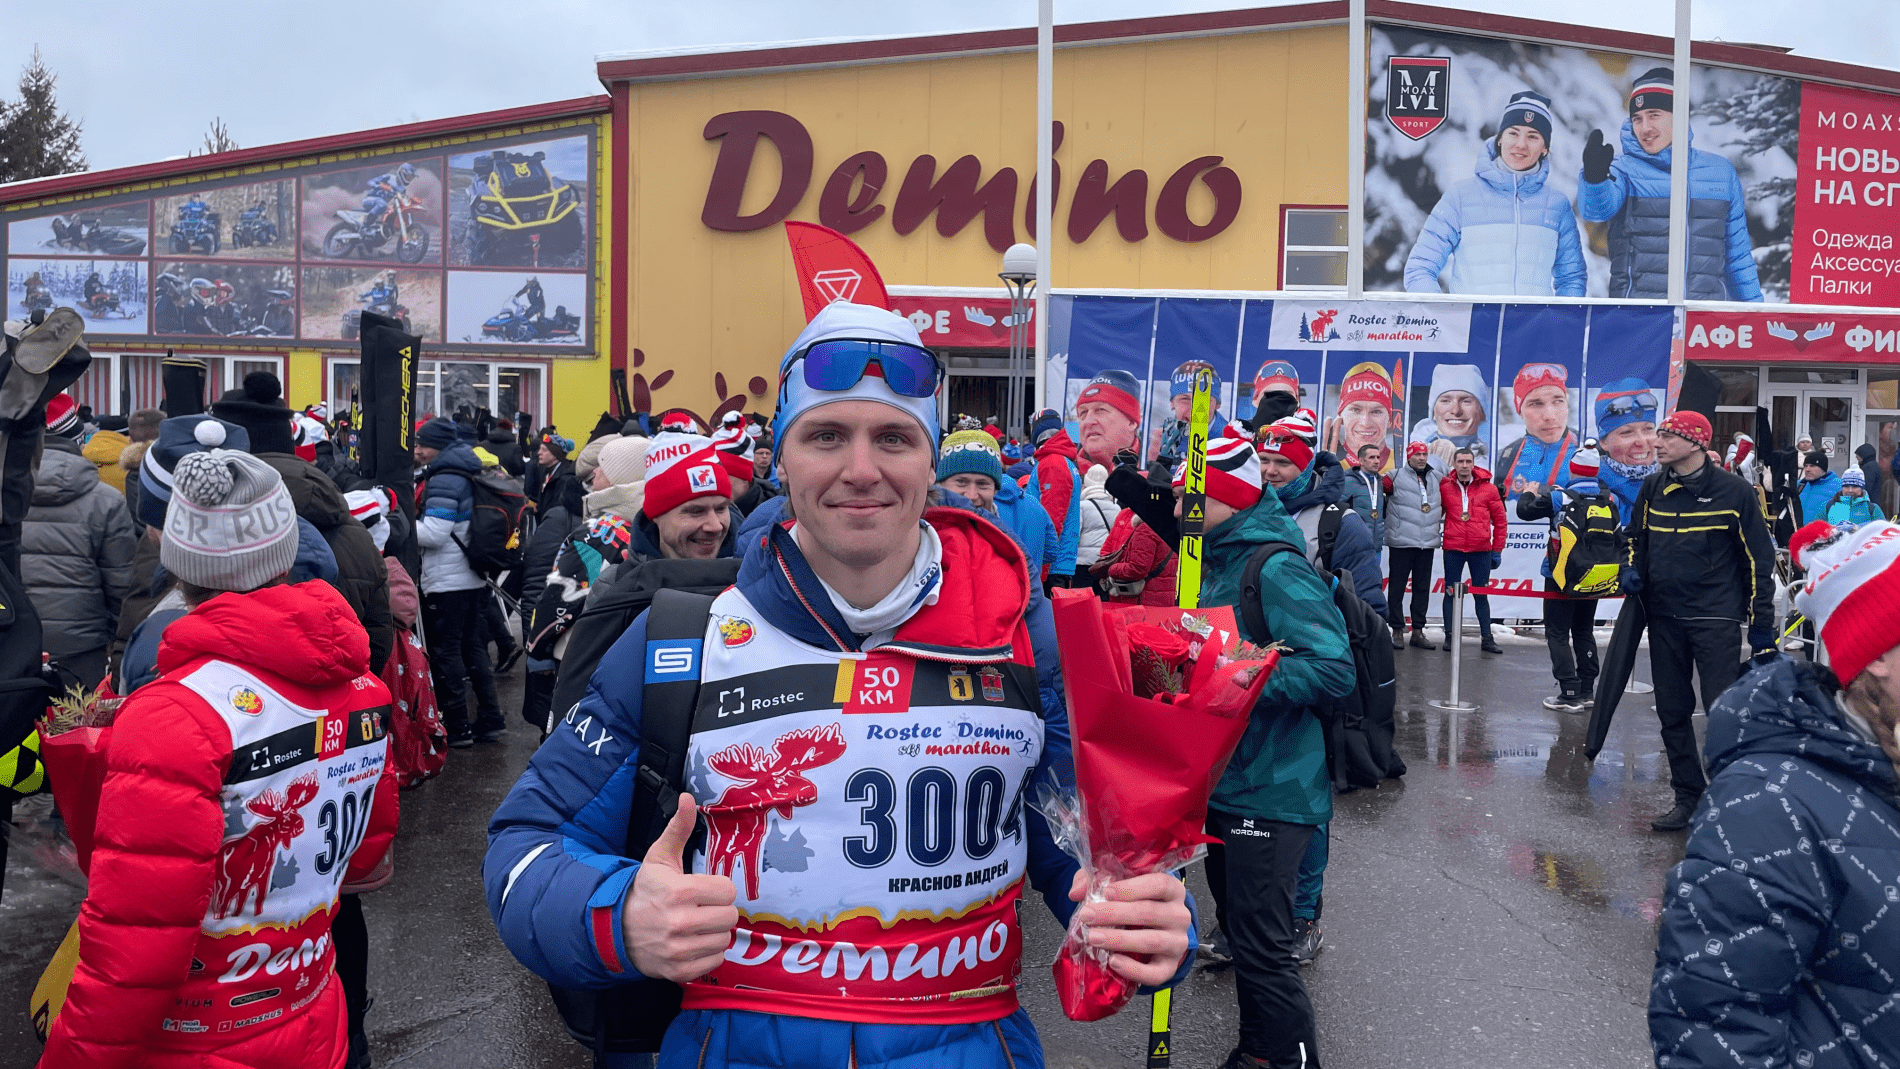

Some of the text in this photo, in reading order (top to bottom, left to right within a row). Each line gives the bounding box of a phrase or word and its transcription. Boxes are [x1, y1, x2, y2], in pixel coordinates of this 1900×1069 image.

[1401, 86, 1435, 95] MOAX
[1817, 110, 1900, 132] MOAX
[701, 110, 1242, 253] Demino
[1814, 179, 1857, 206] НА
[1812, 228, 1893, 251] Одежда
[1810, 252, 1900, 278] Аксессуа
[1809, 275, 1872, 295] Палки
[1348, 314, 1438, 326] Rostec Demino
[1367, 331, 1423, 341] marathon
[1688, 324, 1753, 349] АФЕ
[1844, 324, 1900, 353] ФИ
[1348, 380, 1390, 398] LUKOIL
[400, 357, 412, 452] FISCHER
[862, 666, 901, 689] 50
[751, 691, 805, 711] Rostec
[859, 689, 894, 706] KM
[326, 719, 343, 738] 50
[866, 722, 1025, 741] Rostec Demino
[324, 738, 340, 753] KM
[897, 741, 1011, 758] ski marathon
[274, 748, 302, 765] Rostec
[327, 761, 356, 780] Rostec
[348, 768, 380, 785] marathon
[842, 765, 1035, 870] 3004
[1230, 828, 1270, 838] NORDSKI
[888, 858, 1009, 893] КРАСНОВ АНДРЕЙ
[234, 1008, 283, 1029] MADSHUS
